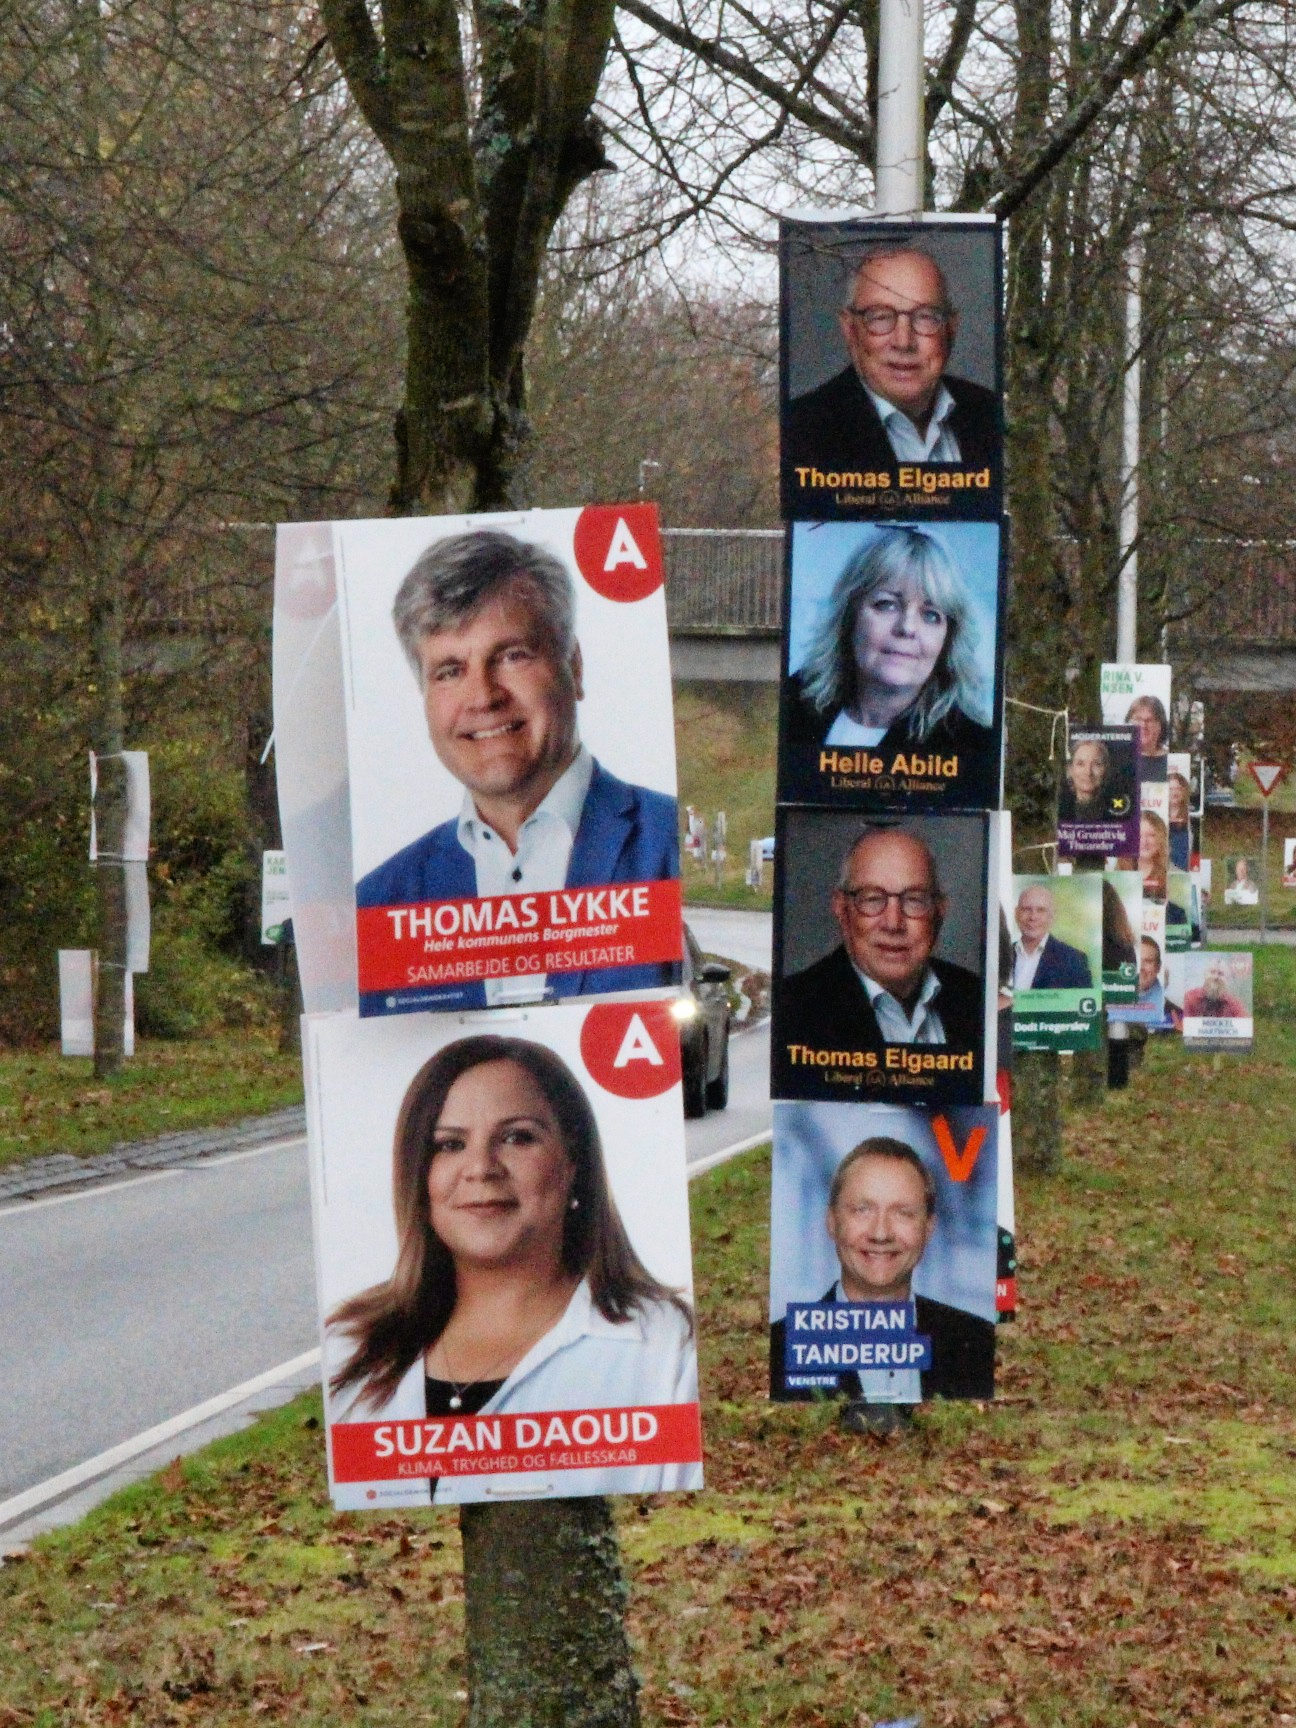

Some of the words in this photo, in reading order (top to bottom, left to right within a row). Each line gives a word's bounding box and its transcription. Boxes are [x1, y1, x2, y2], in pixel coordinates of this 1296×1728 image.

[794, 467, 891, 488] Thomas
[898, 467, 991, 493] Elgaard
[603, 517, 648, 572] A
[819, 751, 883, 774] Helle
[890, 753, 959, 778] Abild
[387, 896, 539, 941] THOMAS
[549, 887, 651, 925] LYKKE
[424, 938, 455, 954] Hele
[457, 931, 540, 951] kommunens
[542, 923, 620, 946] Borgmester
[407, 958, 511, 984] SAMARBEJDE
[515, 954, 541, 973] OG
[547, 945, 636, 970] RESULTATER
[1082, 998, 1092, 1011] C
[613, 1012, 664, 1068] A
[786, 1045, 878, 1067] Thomas
[885, 1048, 975, 1074] Elgaard
[932, 1114, 988, 1182] V
[794, 1309, 906, 1331] KRISTIAN
[792, 1343, 926, 1365] TANDERUP
[788, 1376, 837, 1387] VENSTRE
[373, 1422, 502, 1457] SUZAN
[515, 1411, 659, 1449] DAOUD
[397, 1460, 447, 1476] KLIMA,
[452, 1455, 519, 1472] TRYGHED
[523, 1453, 546, 1468] OG
[550, 1448, 638, 1467] FÆLLESSKAB
